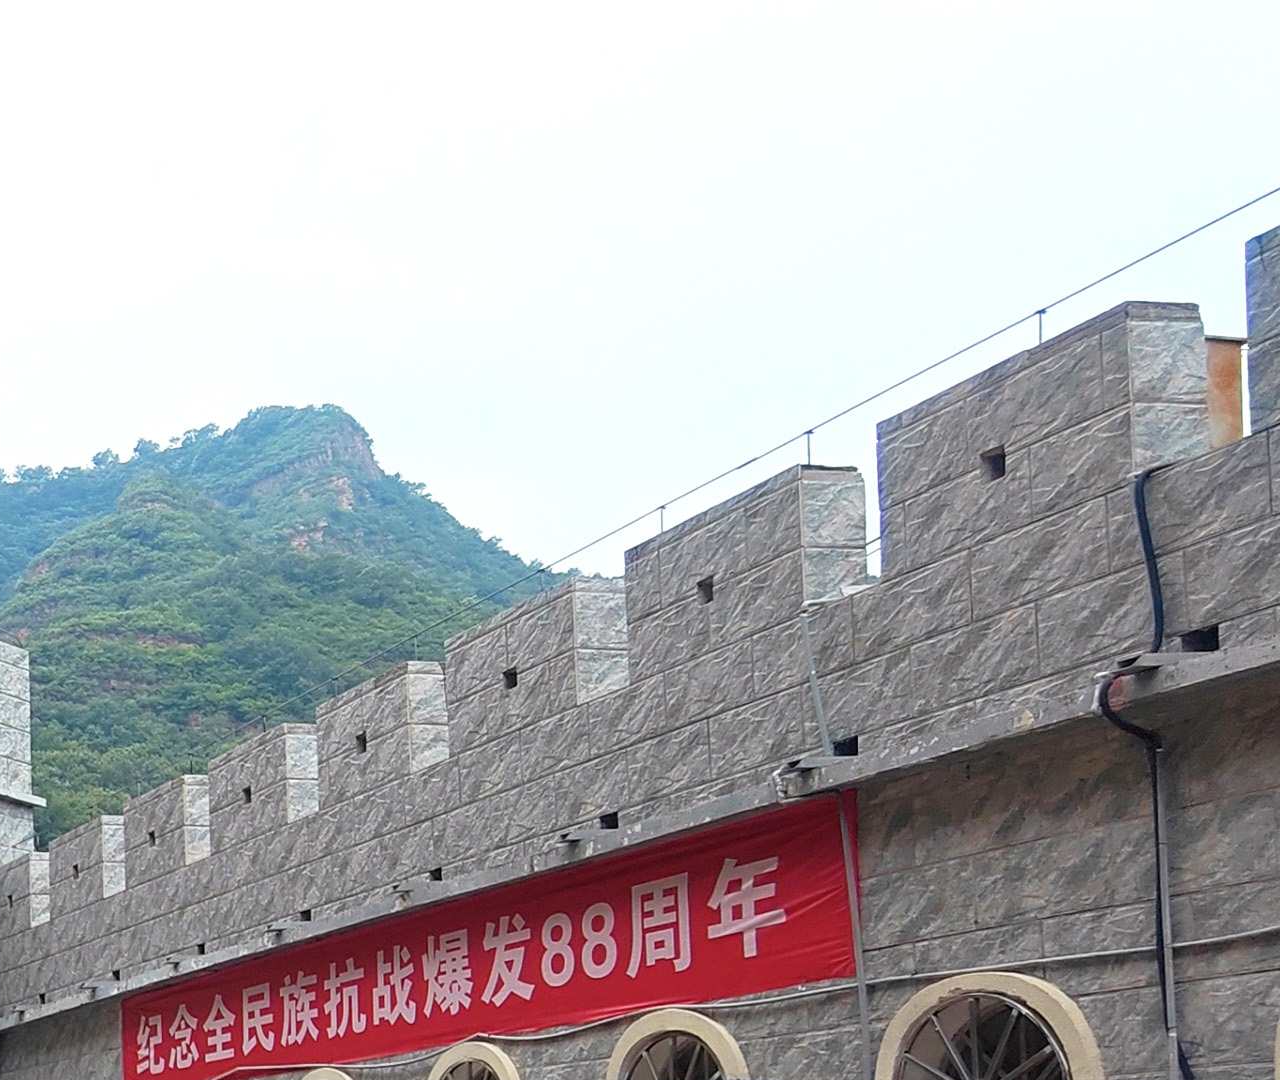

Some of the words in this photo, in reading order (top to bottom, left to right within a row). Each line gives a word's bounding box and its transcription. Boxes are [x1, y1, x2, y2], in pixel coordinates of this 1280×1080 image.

[134, 855, 786, 1077] 纪念全民族抗战爆发88周年
